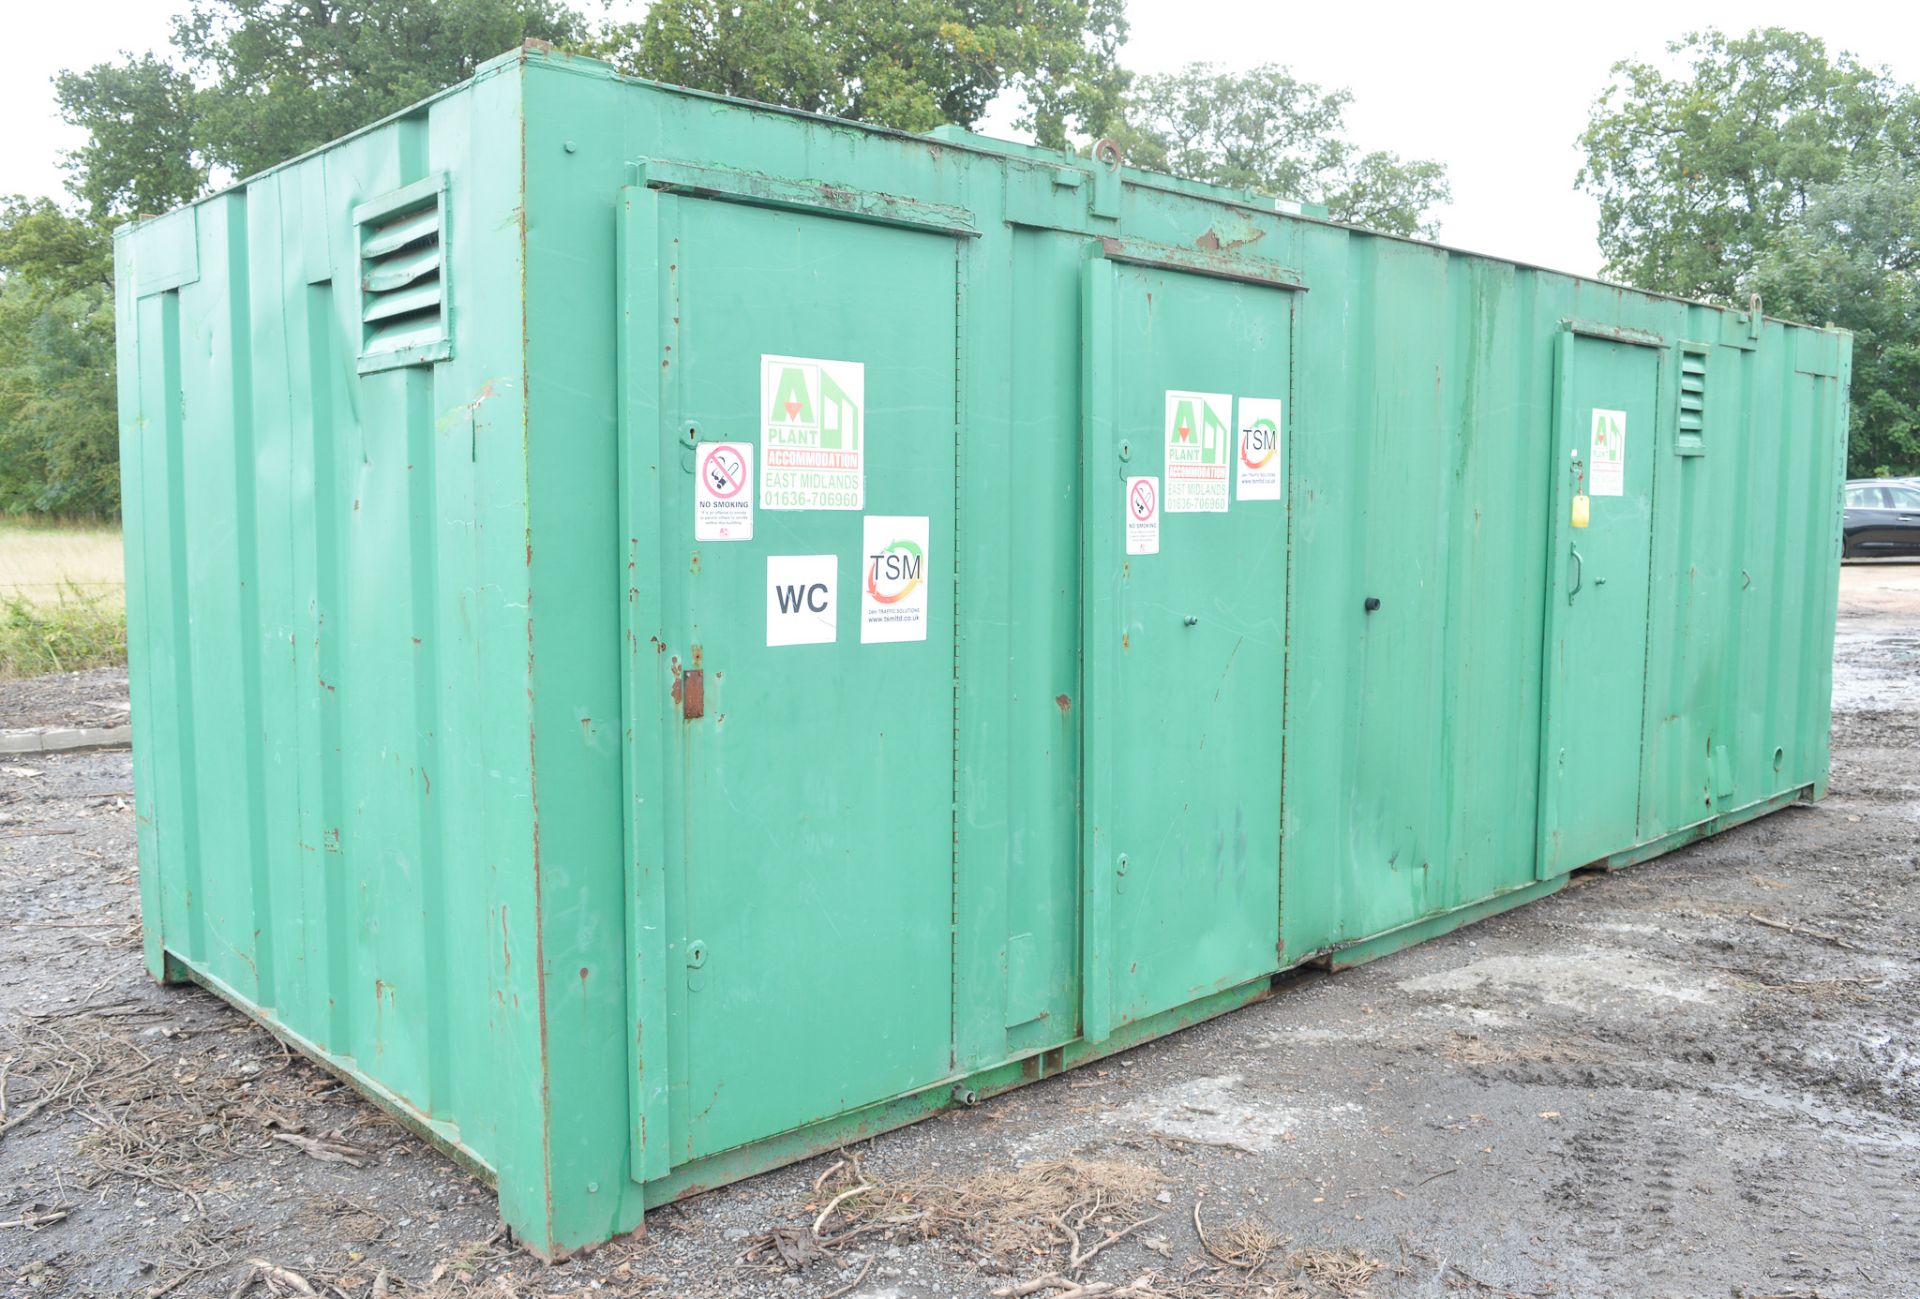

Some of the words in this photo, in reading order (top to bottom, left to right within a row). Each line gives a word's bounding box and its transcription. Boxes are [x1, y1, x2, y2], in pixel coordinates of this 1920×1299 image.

[768, 428, 818, 446] PLANT
[1242, 429, 1276, 451] TSM
[768, 450, 858, 468] ACCOMMODATION
[1169, 448, 1200, 461] PLANT
[766, 472, 797, 488] EAST
[800, 473, 859, 489] MIDLANDS
[765, 490, 858, 507] 01636-706960
[870, 555, 921, 581] TSM
[776, 583, 828, 614] WC
